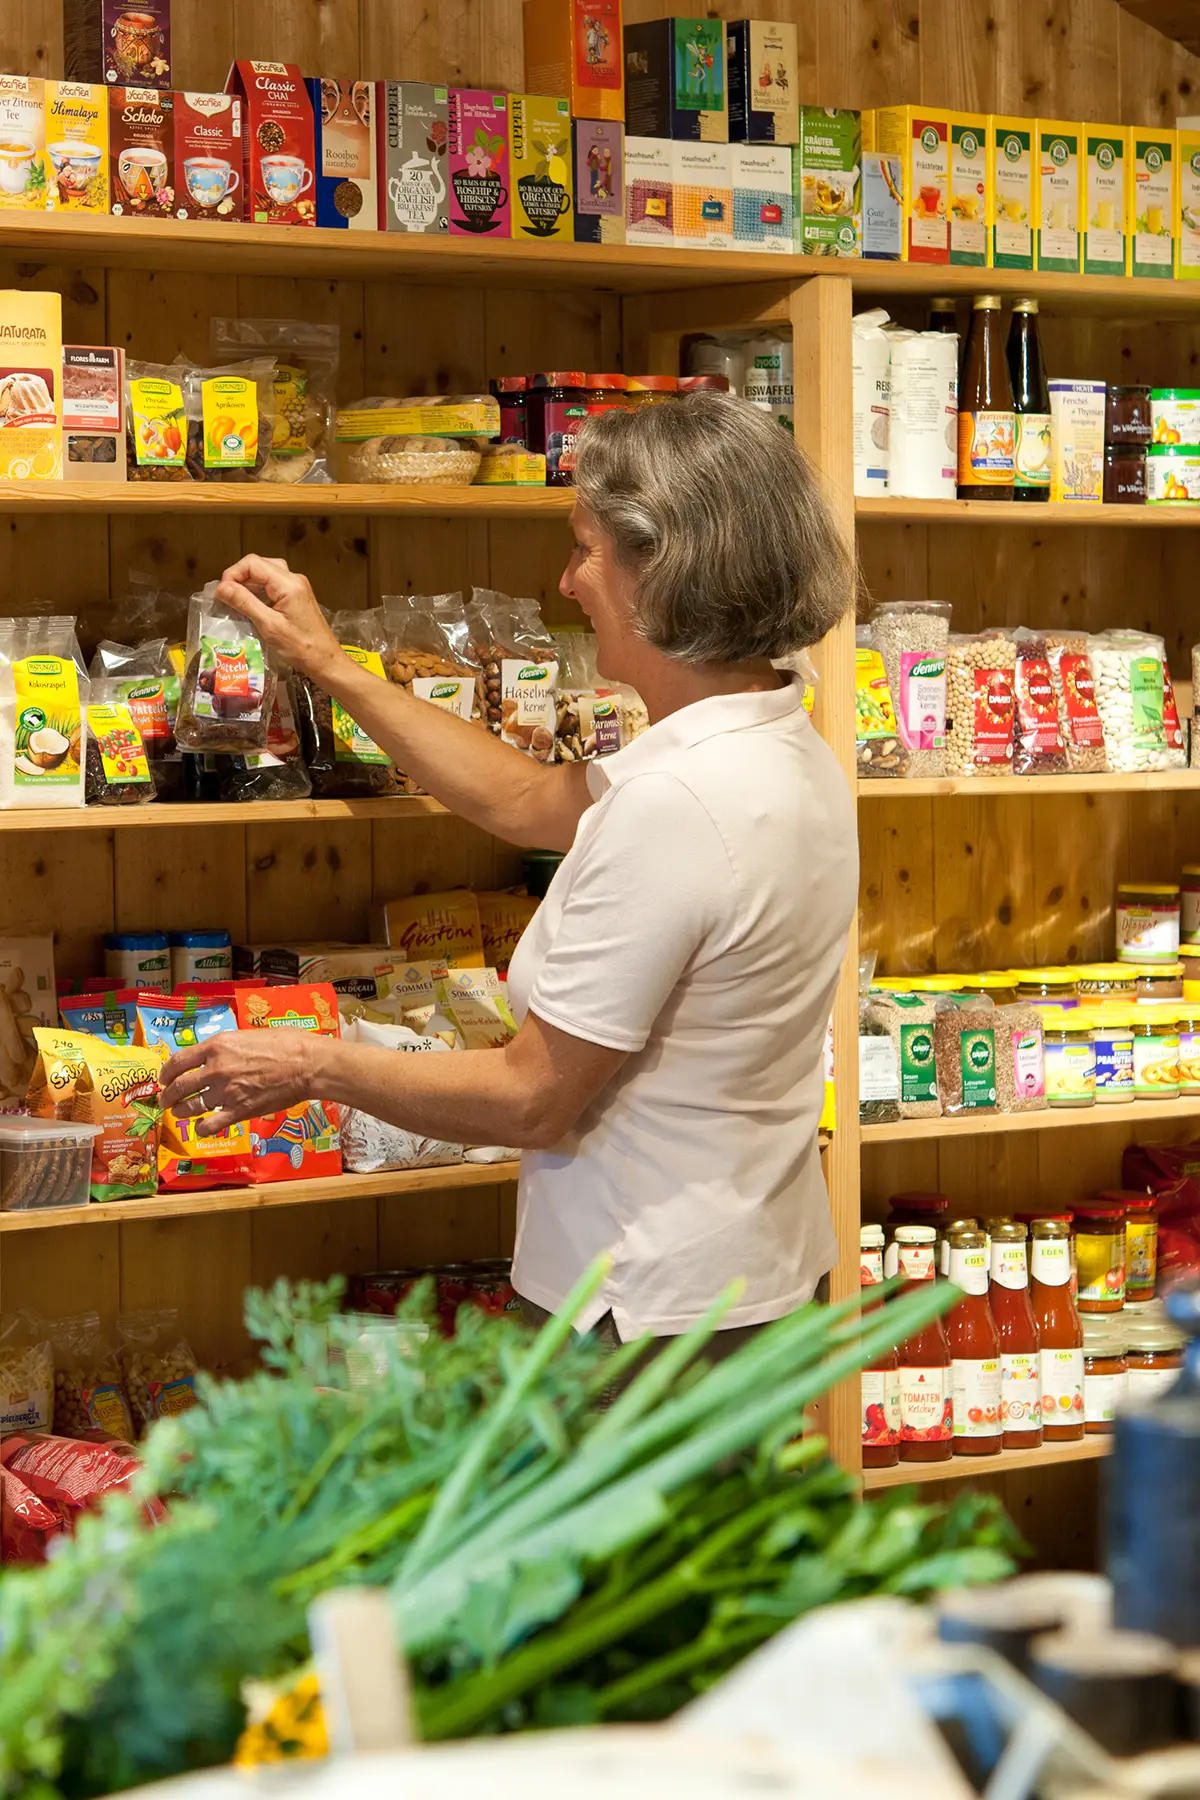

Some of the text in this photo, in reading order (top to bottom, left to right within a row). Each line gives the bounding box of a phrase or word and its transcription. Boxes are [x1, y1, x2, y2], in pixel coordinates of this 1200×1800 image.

[255, 63, 286, 74] YOGI TEA
[14, 79, 27, 90] TEA
[255, 77, 296, 91] Classic
[59, 86, 90, 97] YOGI TEA
[127, 90, 156, 102] YOGI TEA
[268, 91, 288, 100] CHAI
[13, 100, 43, 110] Zitrone
[193, 96, 222, 108] YOGI TEA
[5, 109, 20, 120] Tee
[51, 101, 99, 124] Himalaya
[121, 106, 164, 124] Schoko
[389, 85, 399, 148] CUPPER
[449, 94, 457, 154] CUPPER
[194, 125, 223, 137] Classic
[514, 100, 522, 159] CUPPER
[804, 136, 833, 146] KRÄUTER
[326, 149, 359, 160] Rooibos
[625, 152, 655, 160] Hausfreund
[682, 155, 711, 163] Hausfreund
[740, 160, 770, 168] Hausfreund
[916, 161, 944, 172] Früchtetee
[409, 171, 423, 181] 20
[1050, 176, 1069, 186] Kamille
[1096, 176, 1116, 186] Fenchel
[398, 186, 433, 194] ORGANIC
[457, 186, 499, 196] ROSEHIP &
[552, 187, 564, 195] OUR
[398, 194, 435, 204] ENGLISH
[460, 195, 496, 204] HIBISCUS
[522, 192, 562, 202] ORGANIC
[464, 204, 493, 212] INFUSION
[528, 207, 558, 216] INFUSION
[867, 207, 885, 219] Gute
[407, 210, 425, 220] TEA
[867, 217, 888, 229] Laune
[141, 383, 170, 393] RAPUNZEL
[214, 382, 245, 391] RAPUNZEL
[215, 401, 245, 409] Aprikosen
[1062, 397, 1087, 405] Fenchel
[1078, 408, 1103, 416] Thymian
[458, 421, 469, 429] 250
[29, 663, 59, 672] RAPUNZEL
[216, 658, 249, 671] Datteln
[913, 661, 946, 676] dennree
[29, 681, 66, 690] Kokosraspel
[433, 685, 458, 696] dennree
[918, 684, 942, 693] Sonnen-
[130, 684, 160, 698] dennree
[917, 693, 941, 701] blumen-
[989, 696, 1011, 704] DAVERT
[441, 702, 462, 714] del
[523, 701, 547, 712] kerne
[920, 701, 937, 709] kerne
[600, 731, 617, 741] kerne
[400, 922, 474, 949] Gustoni
[142, 961, 161, 970] Allos
[199, 959, 219, 968] Allos
[348, 984, 375, 992] DUCALE
[451, 989, 486, 998] SOMMER
[270, 1018, 317, 1028] SESAMSTRASSE
[101, 1068, 157, 1102] SAMBA
[124, 1083, 154, 1104] MINIS
[1003, 1250, 1026, 1259] EDEN
[964, 1257, 985, 1265] EDEN
[1012, 1359, 1029, 1367] EDEN
[903, 1392, 941, 1402] TOMATEN
[907, 1404, 936, 1416] Ketchup
